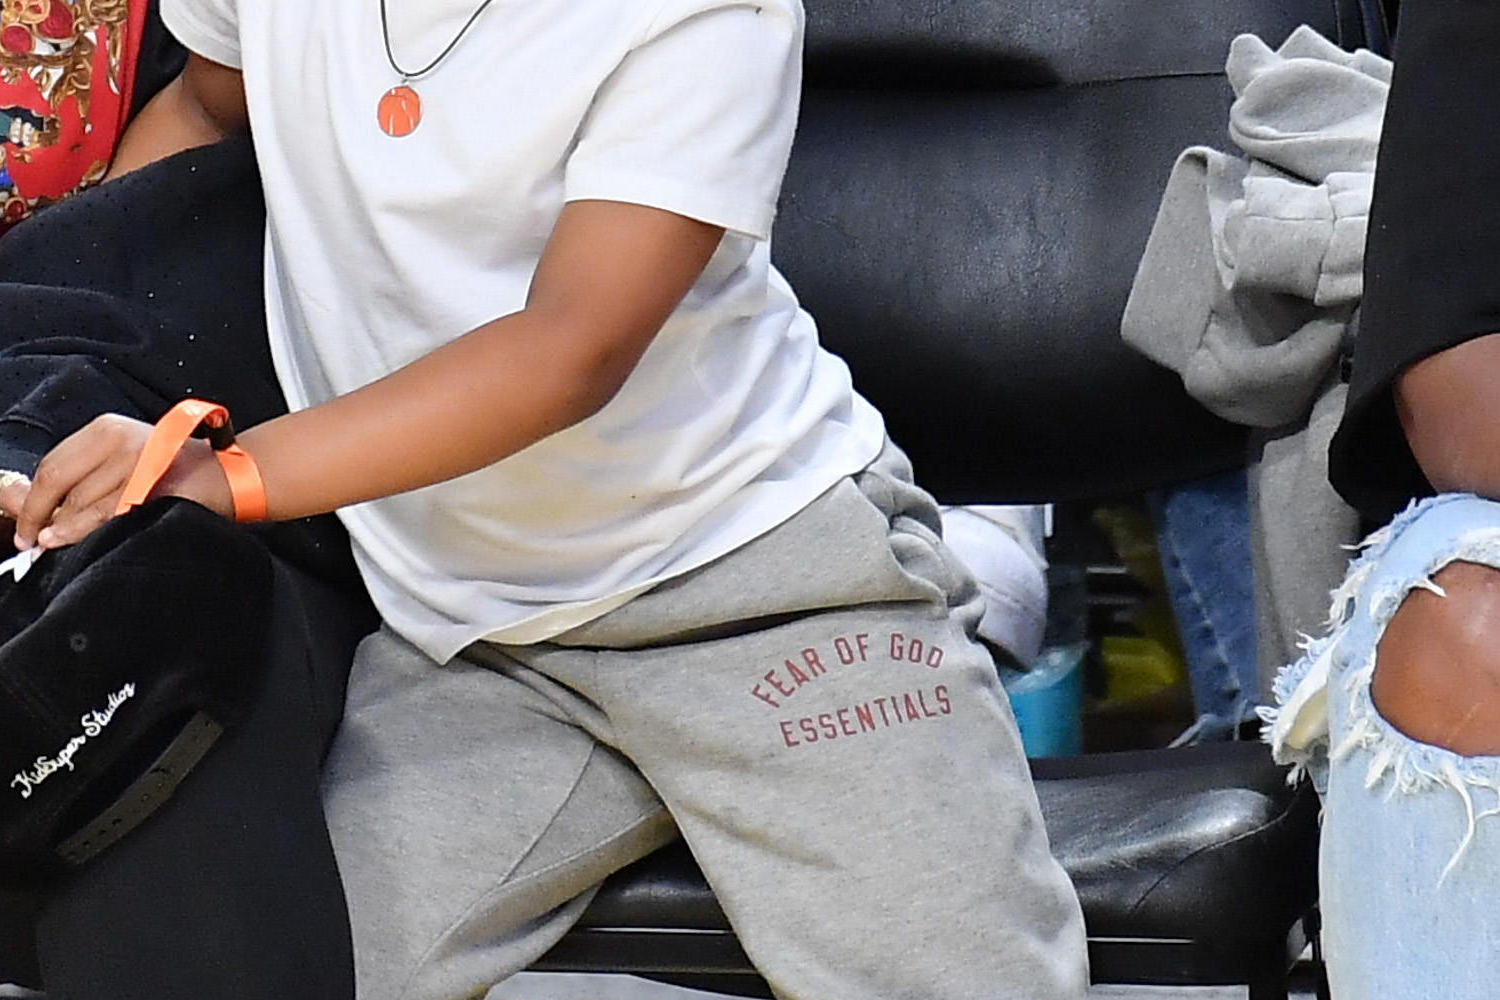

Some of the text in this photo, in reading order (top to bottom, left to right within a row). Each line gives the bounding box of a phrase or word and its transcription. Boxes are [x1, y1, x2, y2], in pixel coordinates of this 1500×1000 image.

[751, 633, 944, 708] FEAR OF GOD
[81, 681, 136, 737] Studios
[780, 685, 952, 748] ESSENTIALS
